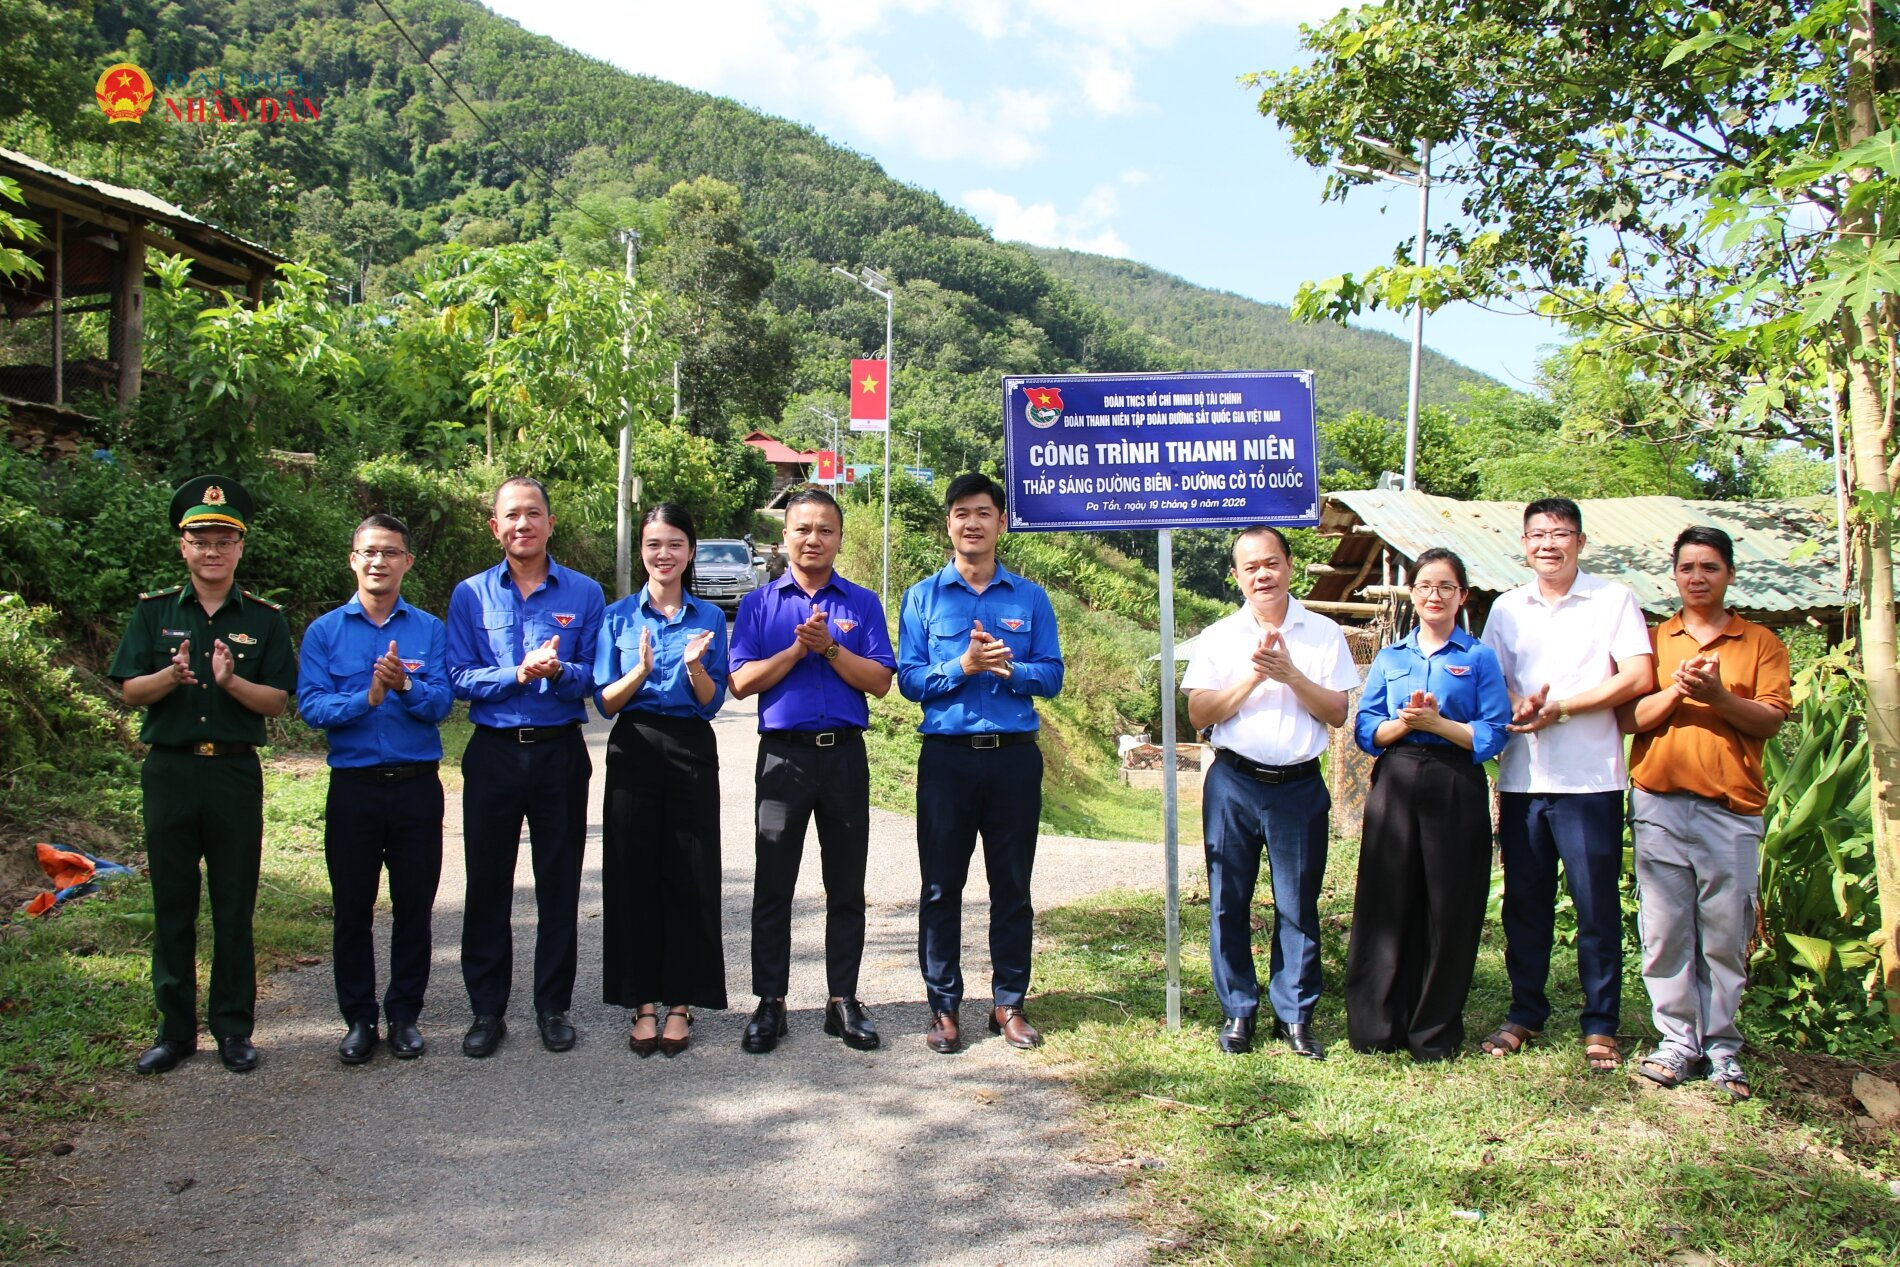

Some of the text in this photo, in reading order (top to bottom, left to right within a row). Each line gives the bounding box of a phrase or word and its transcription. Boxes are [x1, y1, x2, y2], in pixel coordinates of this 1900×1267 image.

[1103, 393, 1125, 408] ĐOÀN
[1126, 395, 1146, 408] TNCS
[1158, 391, 1172, 407] CHÍ
[1173, 393, 1193, 407] MINH
[1194, 391, 1205, 408] BỘ
[1205, 390, 1218, 406] TÀI
[1219, 390, 1242, 405] CHÍNH
[1063, 413, 1085, 428] ĐOÀN
[1086, 414, 1111, 428] THANH
[1111, 411, 1130, 427] NIÊN
[1131, 411, 1146, 429] TẬP
[1146, 411, 1168, 426] ĐOÀN
[1168, 409, 1194, 425] ĐƯỜNG
[1210, 407, 1231, 425] QUỐC
[1232, 410, 1246, 424] GIA
[1246, 408, 1262, 425] VIỆT
[1263, 410, 1281, 423] NAM
[1029, 434, 1295, 467] CÔNG TRÌNH THANH NIÊN
[1023, 469, 1056, 495] THẮP
[1058, 474, 1093, 494] SÁNG
[1096, 472, 1141, 493] ĐƯỜNG
[1144, 471, 1172, 492] BIÊN
[1181, 470, 1226, 491] ĐƯỜNG
[1229, 469, 1247, 490] CỜ
[1249, 464, 1266, 490] TỔ
[1268, 465, 1304, 489] QUỐC
[1086, 501, 1099, 511] Pa
[1124, 499, 1147, 512] ngày
[1149, 499, 1159, 509] 19
[1161, 498, 1188, 511] tháng
[1190, 499, 1198, 509] 9
[1199, 498, 1220, 509] năm
[1222, 497, 1246, 508] 2026
